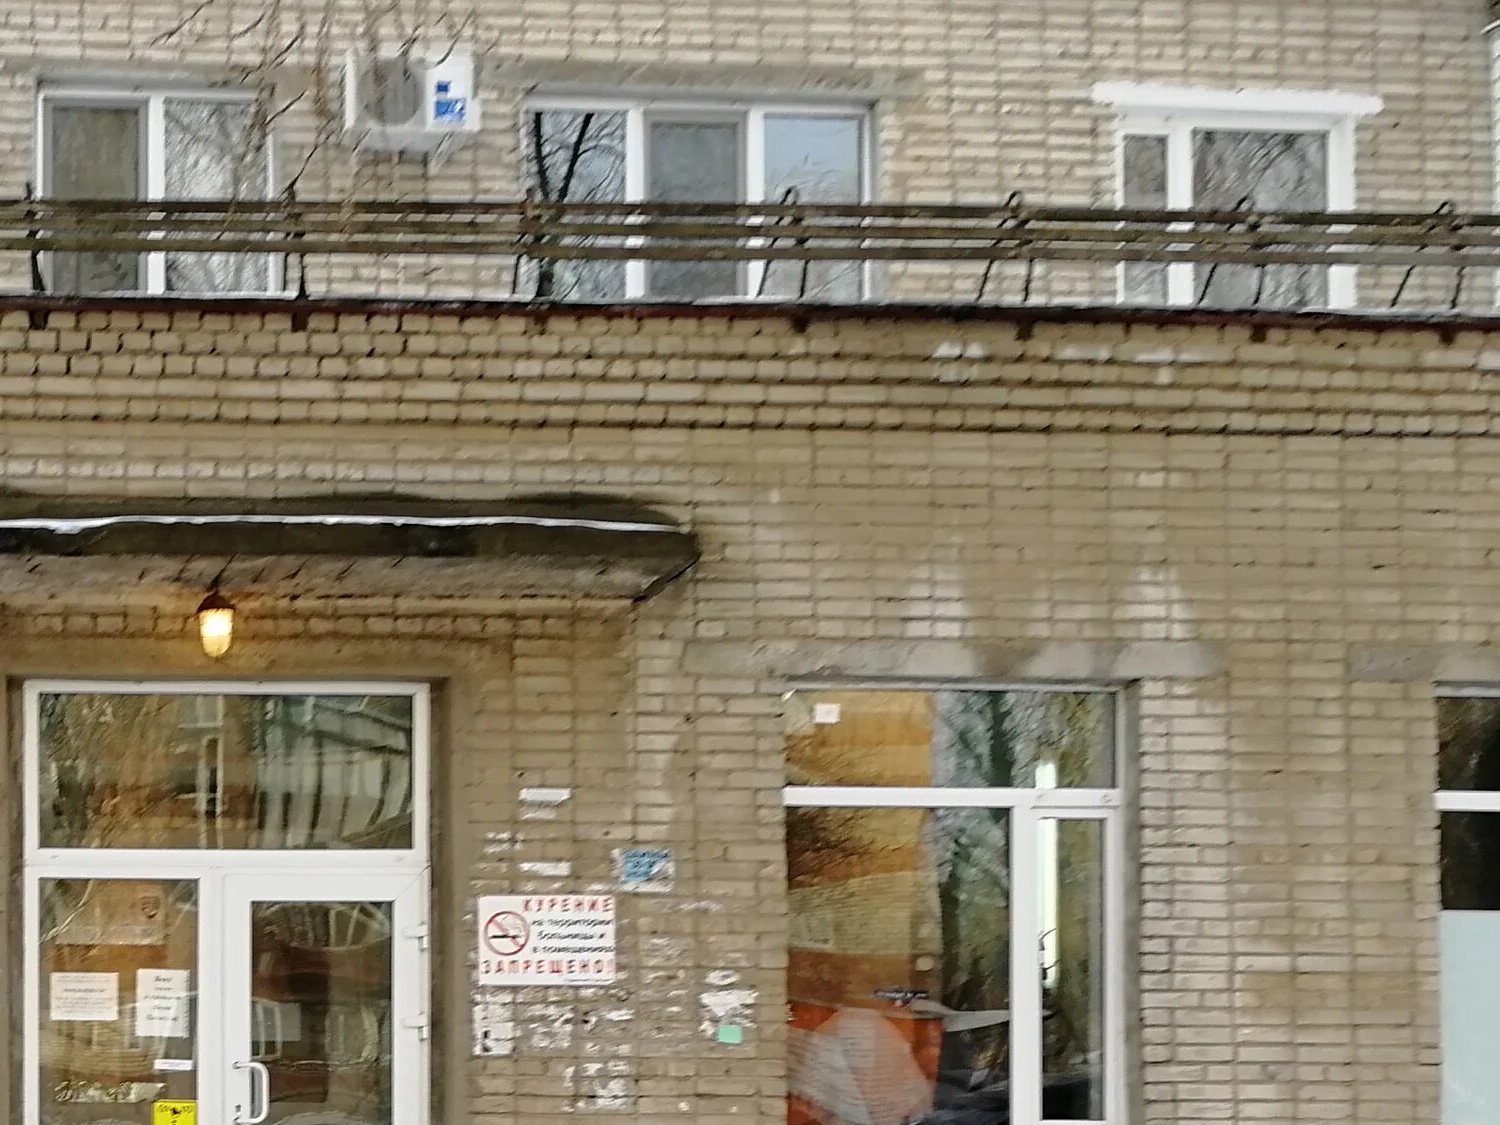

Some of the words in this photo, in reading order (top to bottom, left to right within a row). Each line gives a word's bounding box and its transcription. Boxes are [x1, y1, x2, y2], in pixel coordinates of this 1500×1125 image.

[523, 897, 613, 912] КУРЕНИЕ
[548, 918, 613, 928] территории
[537, 930, 595, 940] больницы
[542, 945, 615, 954] помещениях
[481, 959, 615, 975] ЗАПРЕЩЕНО!
